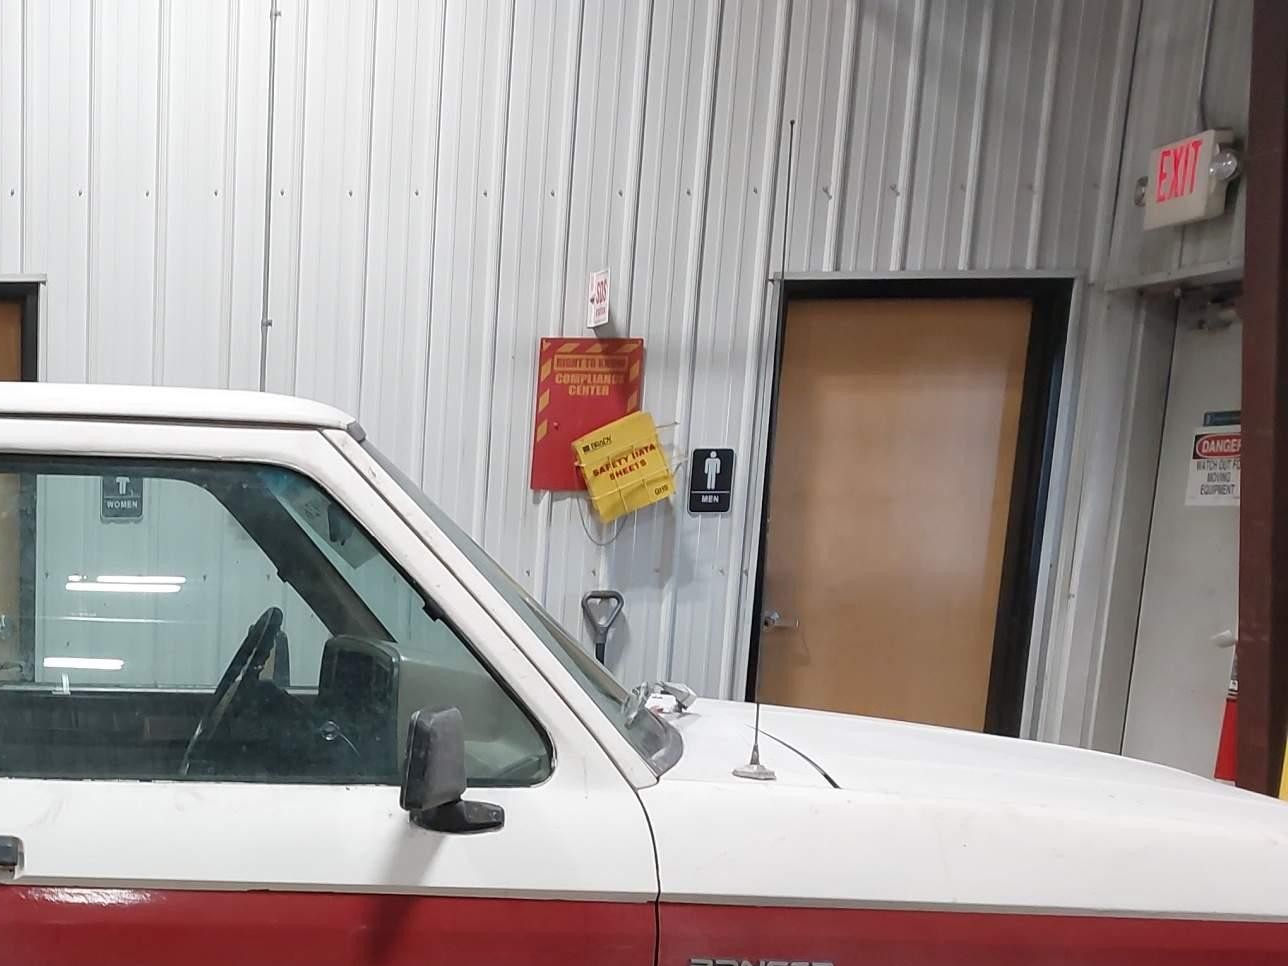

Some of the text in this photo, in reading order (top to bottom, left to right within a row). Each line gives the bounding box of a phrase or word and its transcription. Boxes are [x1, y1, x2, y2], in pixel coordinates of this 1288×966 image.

[1157, 140, 1203, 203] EXIT
[596, 279, 608, 304] SDS
[555, 374, 625, 385] COMPLIANCE
[568, 384, 609, 396] CENTER
[592, 443, 656, 477] SAFETY DATA
[609, 459, 647, 481] SHEETS
[1200, 484, 1235, 495] EQUIPMENT
[107, 500, 138, 509] WOMEN
[702, 495, 719, 503] MEN
